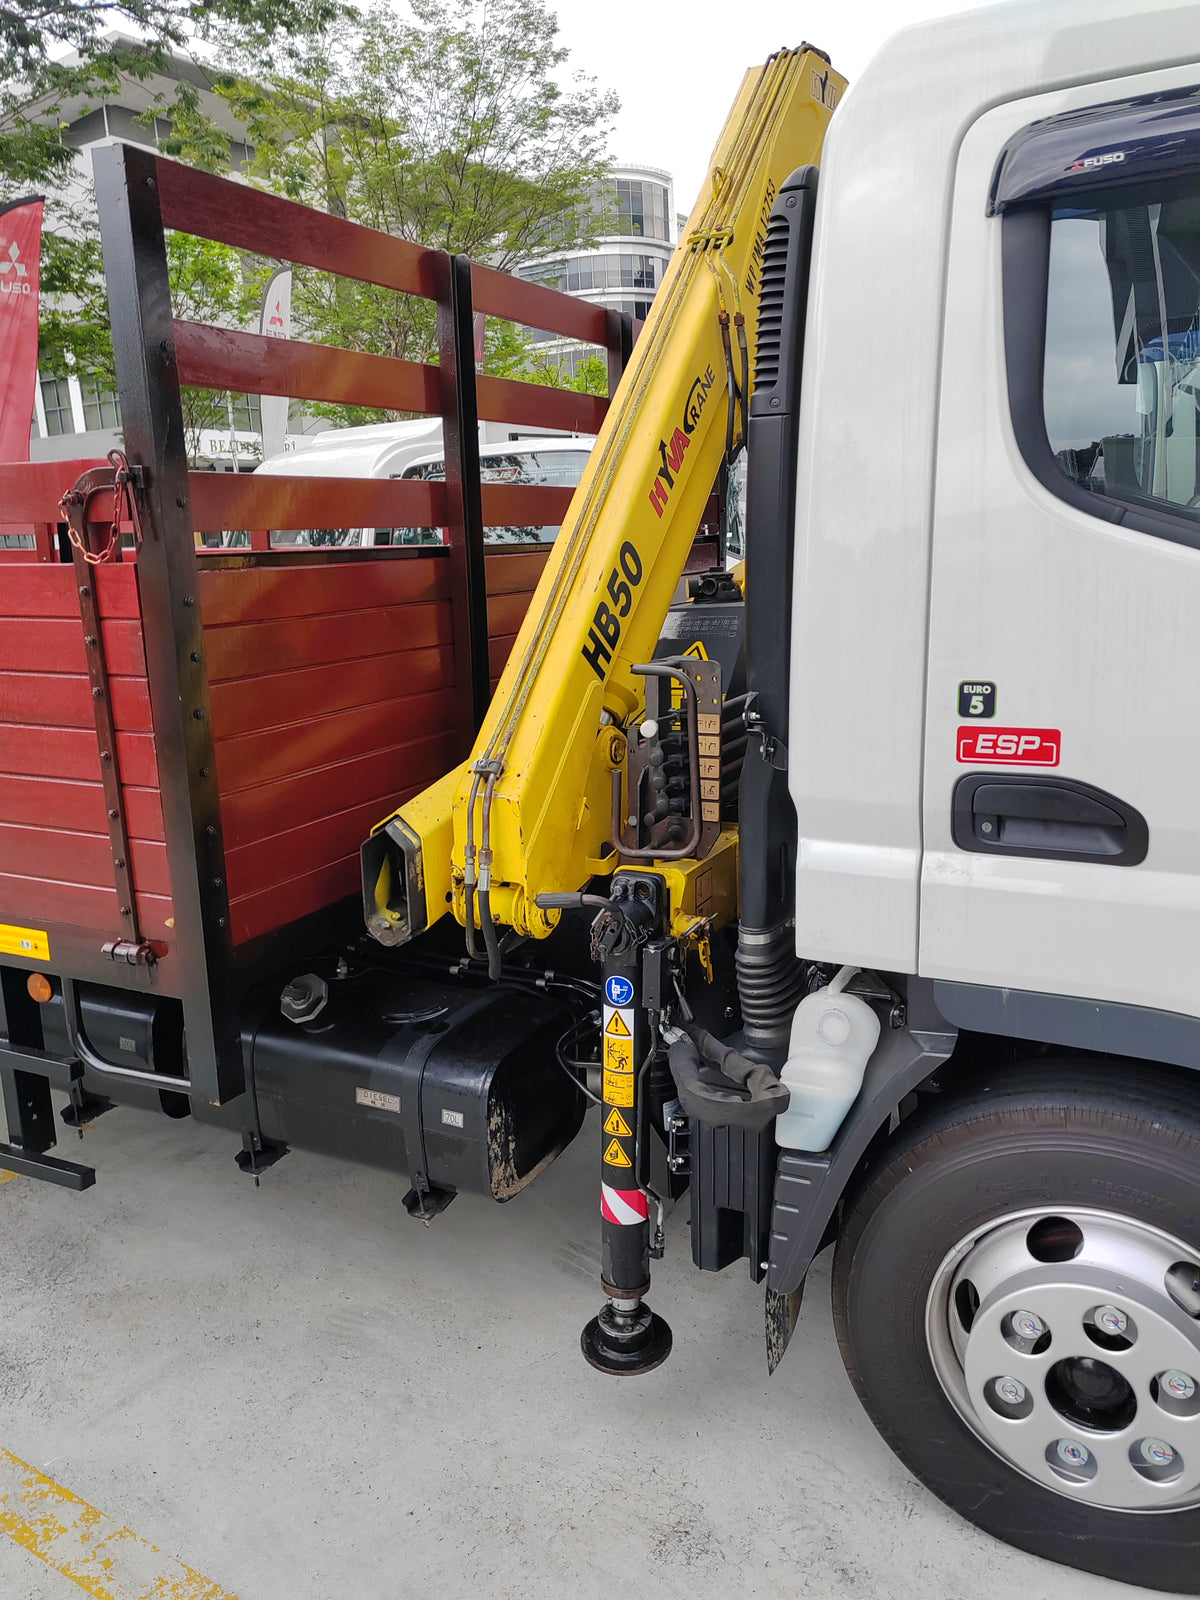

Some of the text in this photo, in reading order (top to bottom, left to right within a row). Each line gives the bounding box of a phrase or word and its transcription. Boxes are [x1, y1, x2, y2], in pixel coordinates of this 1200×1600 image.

[1083, 152, 1124, 168] FUSO
[760, 178, 776, 230] 12753
[649, 363, 716, 519] HYVA CRANE
[581, 541, 643, 682] HB50
[963, 685, 992, 695] EURO
[968, 695, 985, 715] 5
[975, 733, 1041, 756] ESP
[363, 1090, 393, 1104] DIESEL
[446, 1112, 460, 1124] 70L
